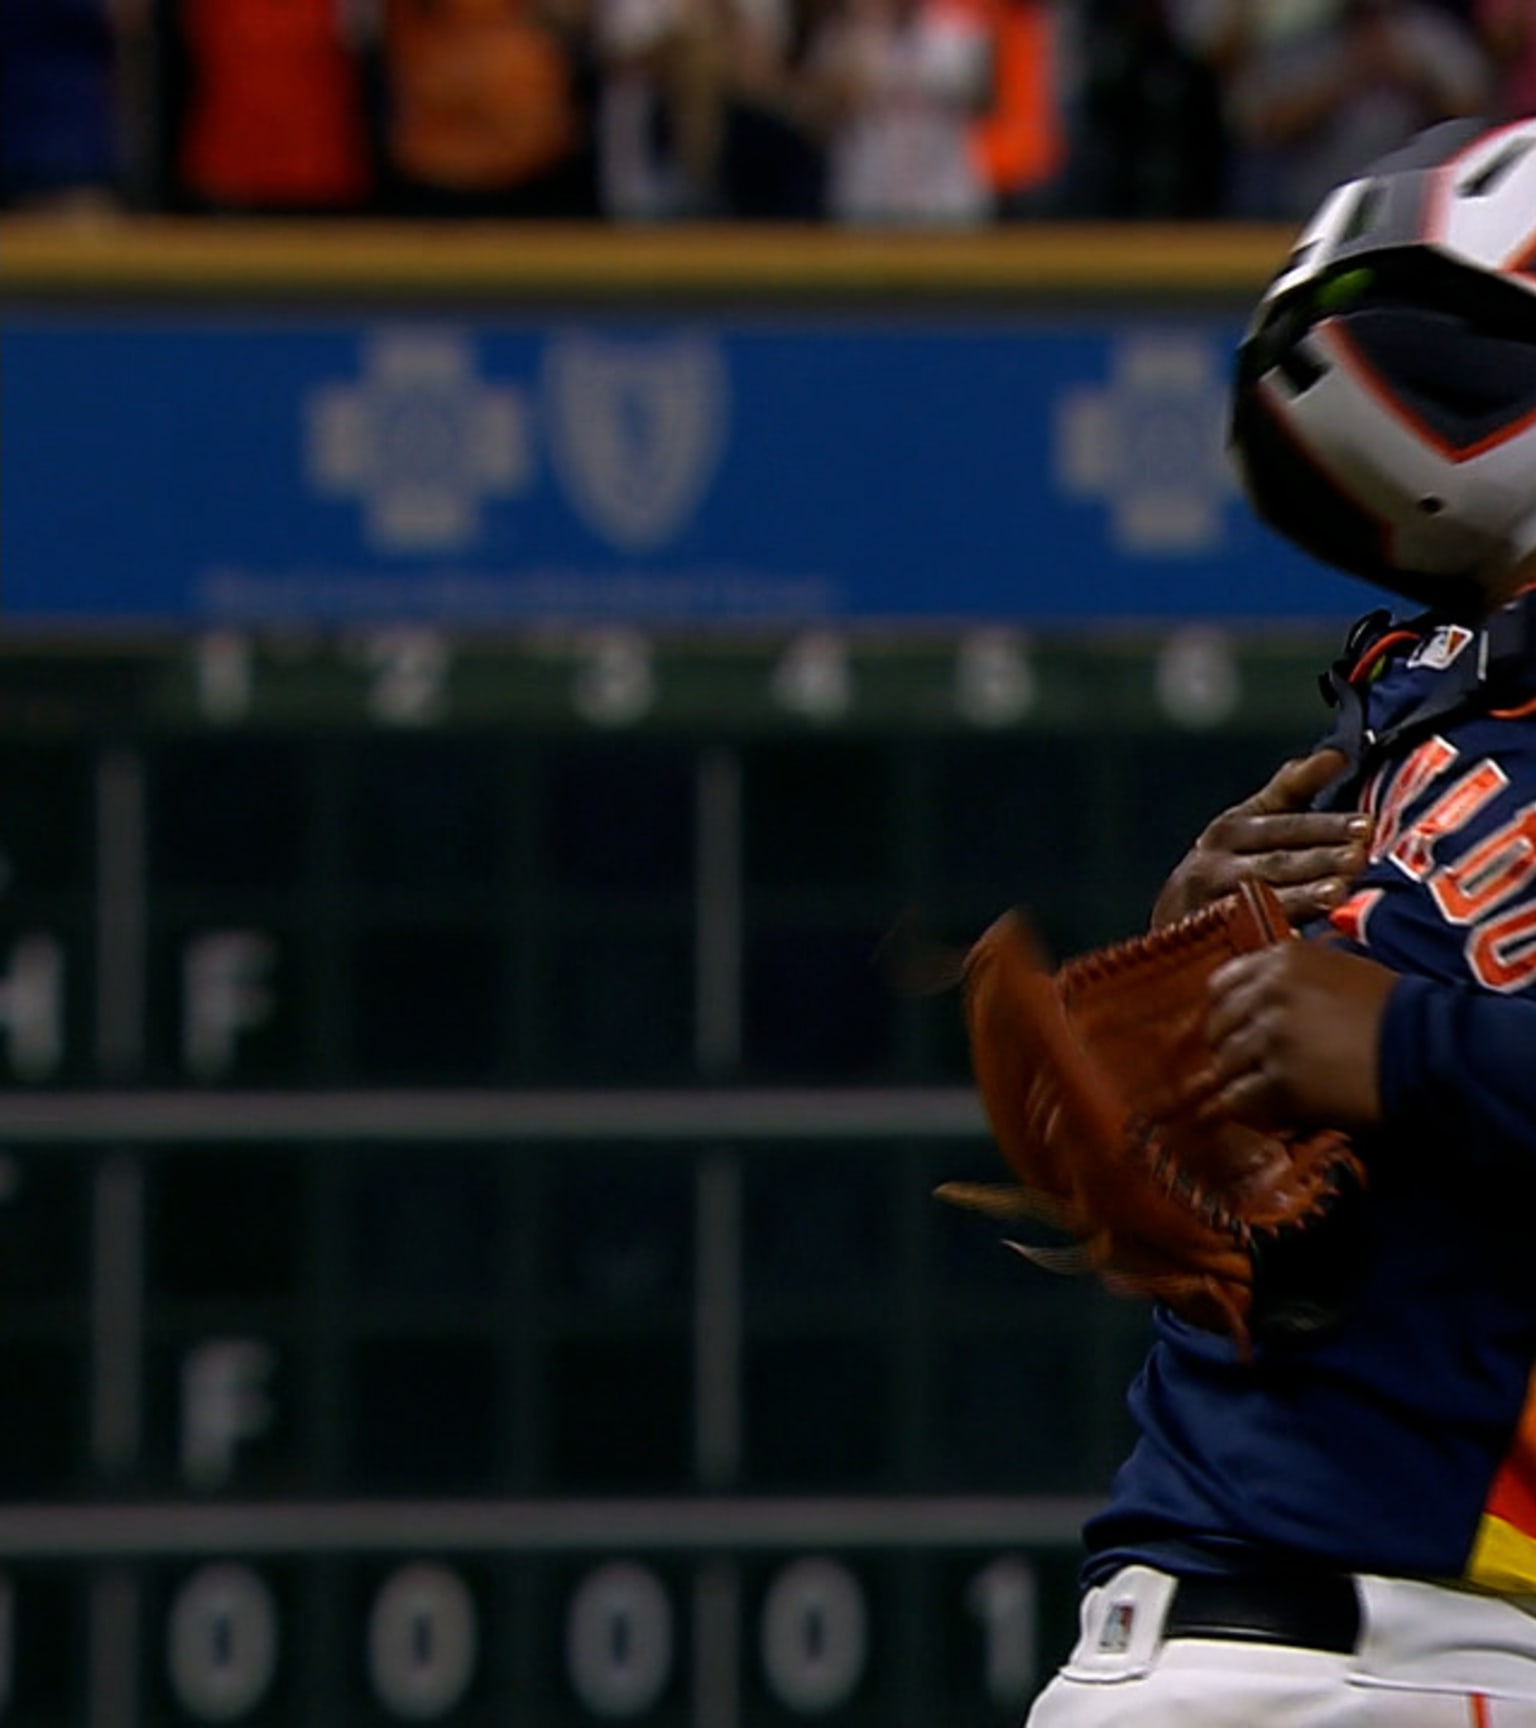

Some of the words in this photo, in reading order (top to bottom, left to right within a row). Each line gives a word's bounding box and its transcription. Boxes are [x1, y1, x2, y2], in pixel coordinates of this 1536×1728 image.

[194, 634, 253, 726] 1
[364, 634, 452, 728] 2
[572, 634, 656, 728] 3
[1154, 630, 1241, 728] 6
[180, 928, 275, 1080] F
[178, 1336, 275, 1490] F
[165, 1558, 280, 1722] 0
[366, 1558, 480, 1722] 0
[564, 1557, 676, 1722] 0
[758, 1553, 870, 1716] 0
[968, 1553, 1041, 1706] 1
